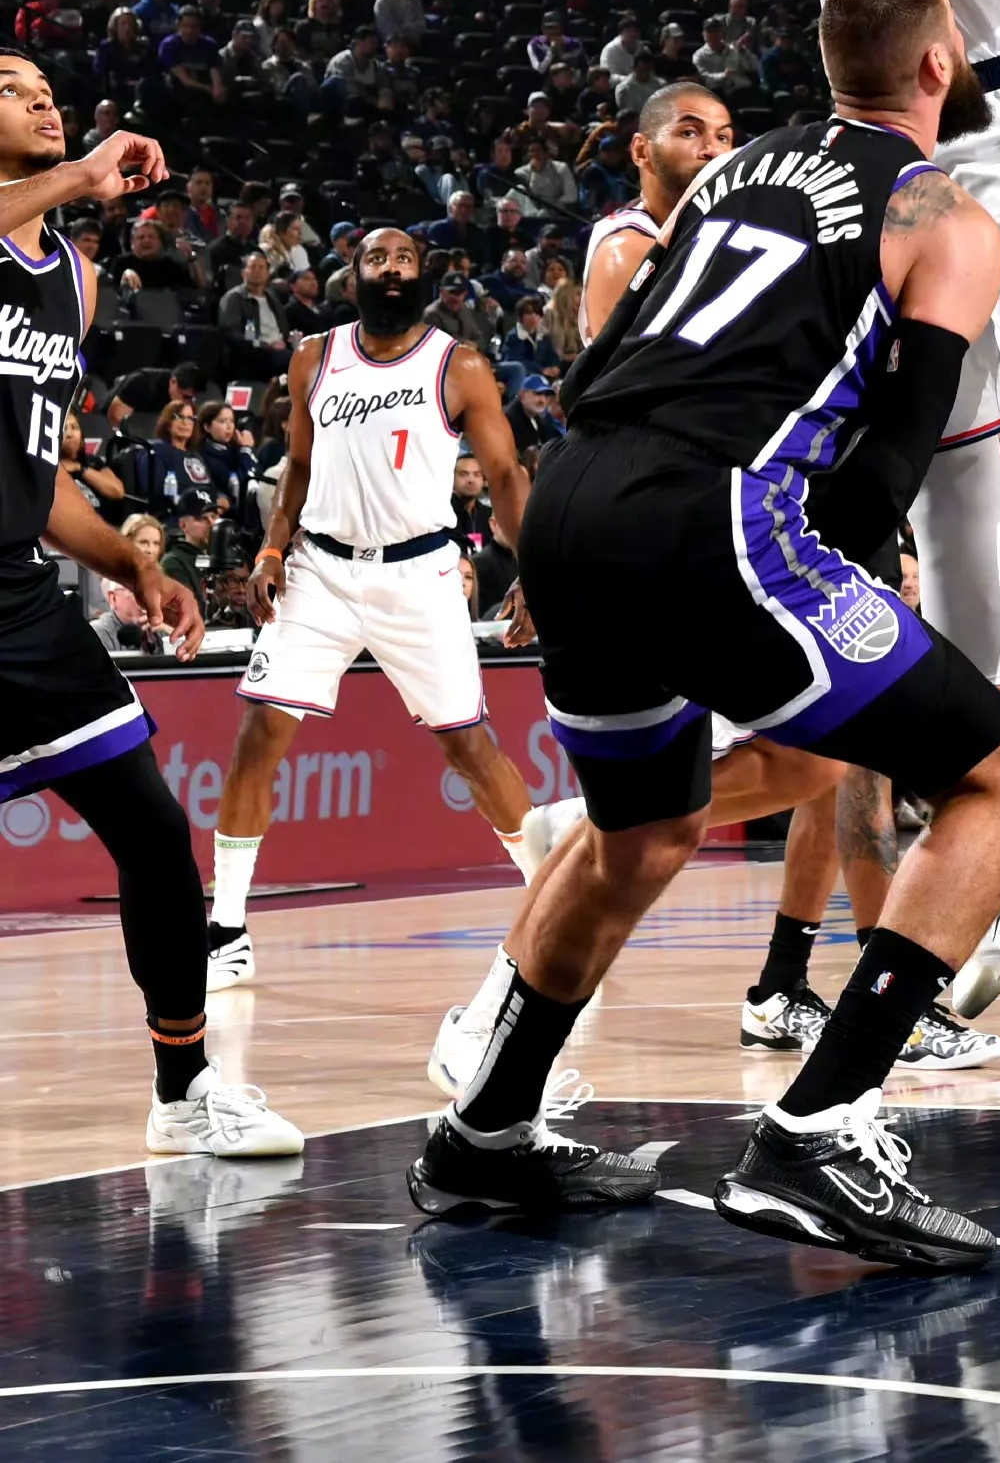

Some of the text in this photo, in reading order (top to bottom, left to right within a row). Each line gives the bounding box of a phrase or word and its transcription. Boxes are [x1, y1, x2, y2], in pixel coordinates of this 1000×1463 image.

[638, 217, 812, 350] 17
[0, 304, 76, 385] Kings
[26, 391, 62, 466] 13
[319, 386, 428, 428] Clippers
[391, 429, 409, 471] 1
[827, 591, 873, 637] SACRAMENTO
[831, 598, 887, 652] KINGS
[271, 748, 373, 825] arm
